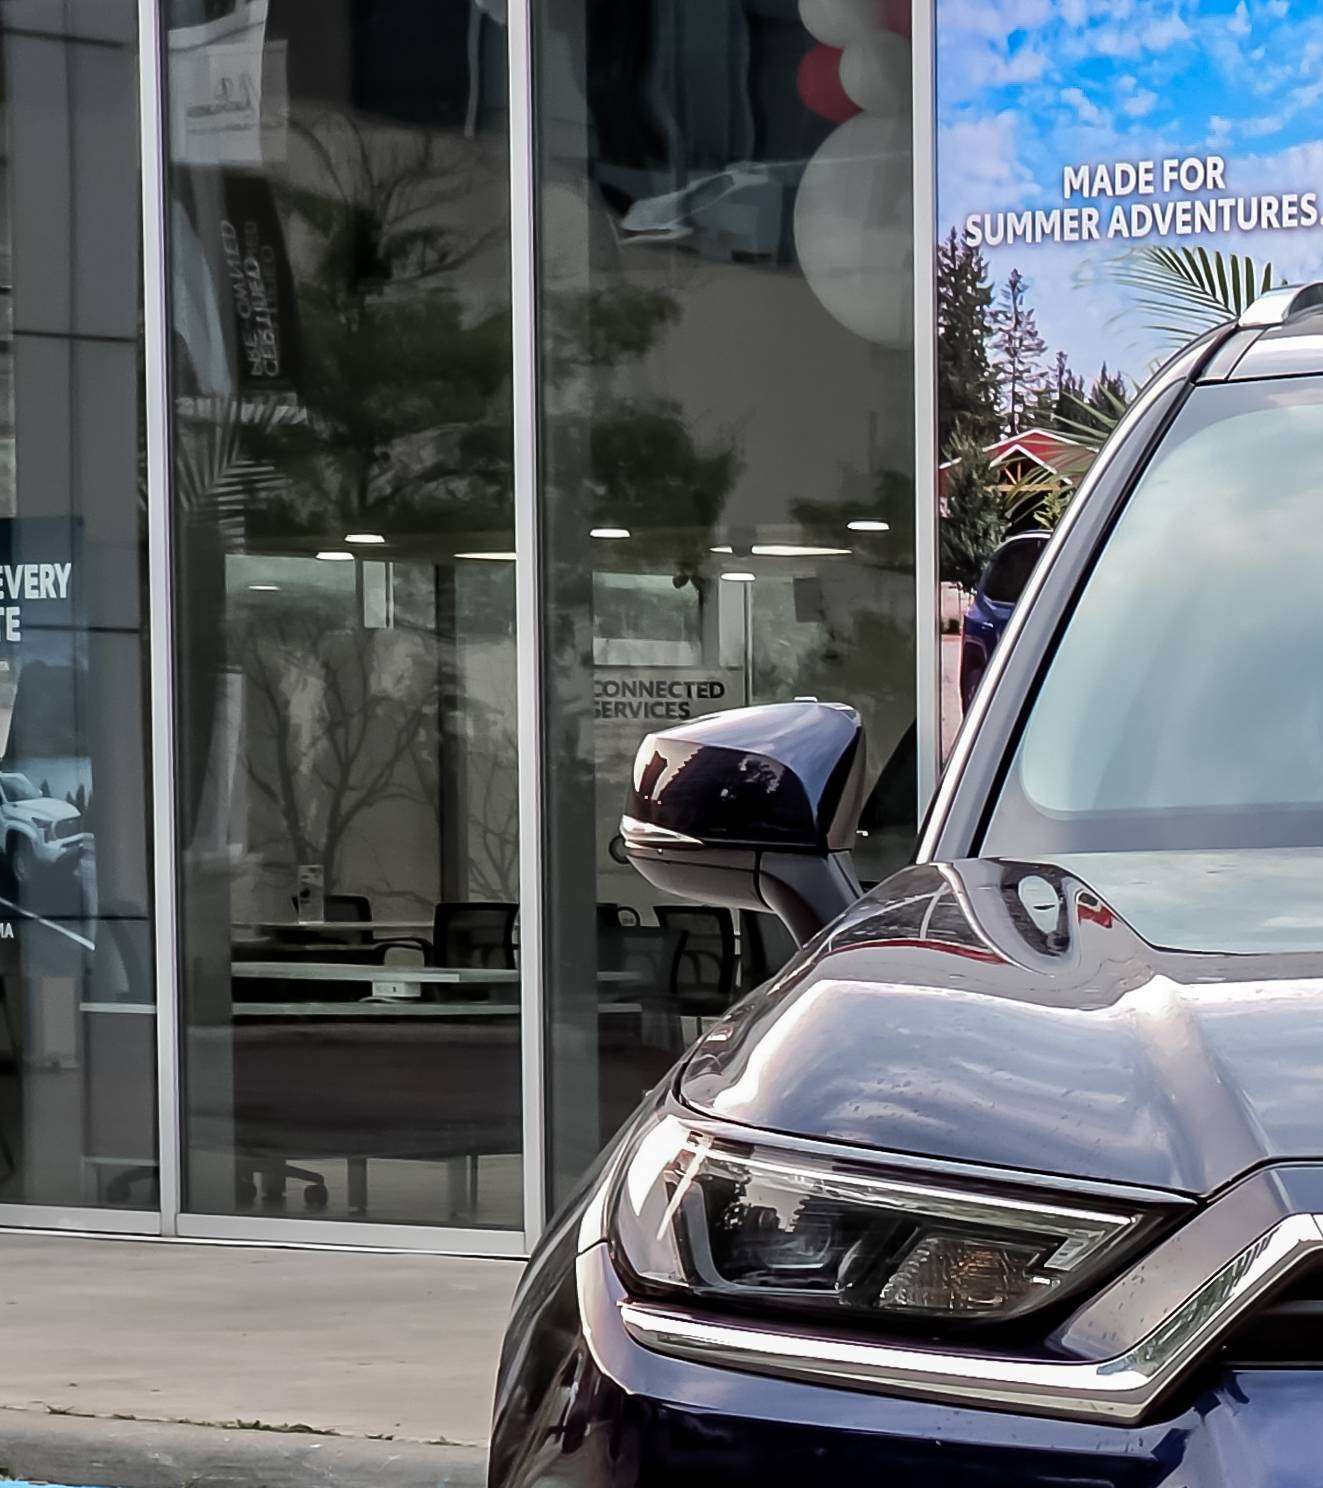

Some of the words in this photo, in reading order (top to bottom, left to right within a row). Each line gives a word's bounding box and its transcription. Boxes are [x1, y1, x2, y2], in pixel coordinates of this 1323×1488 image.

[1063, 161, 1154, 199] MADE
[1163, 155, 1226, 192] FOR
[964, 206, 1100, 248] SUMMER
